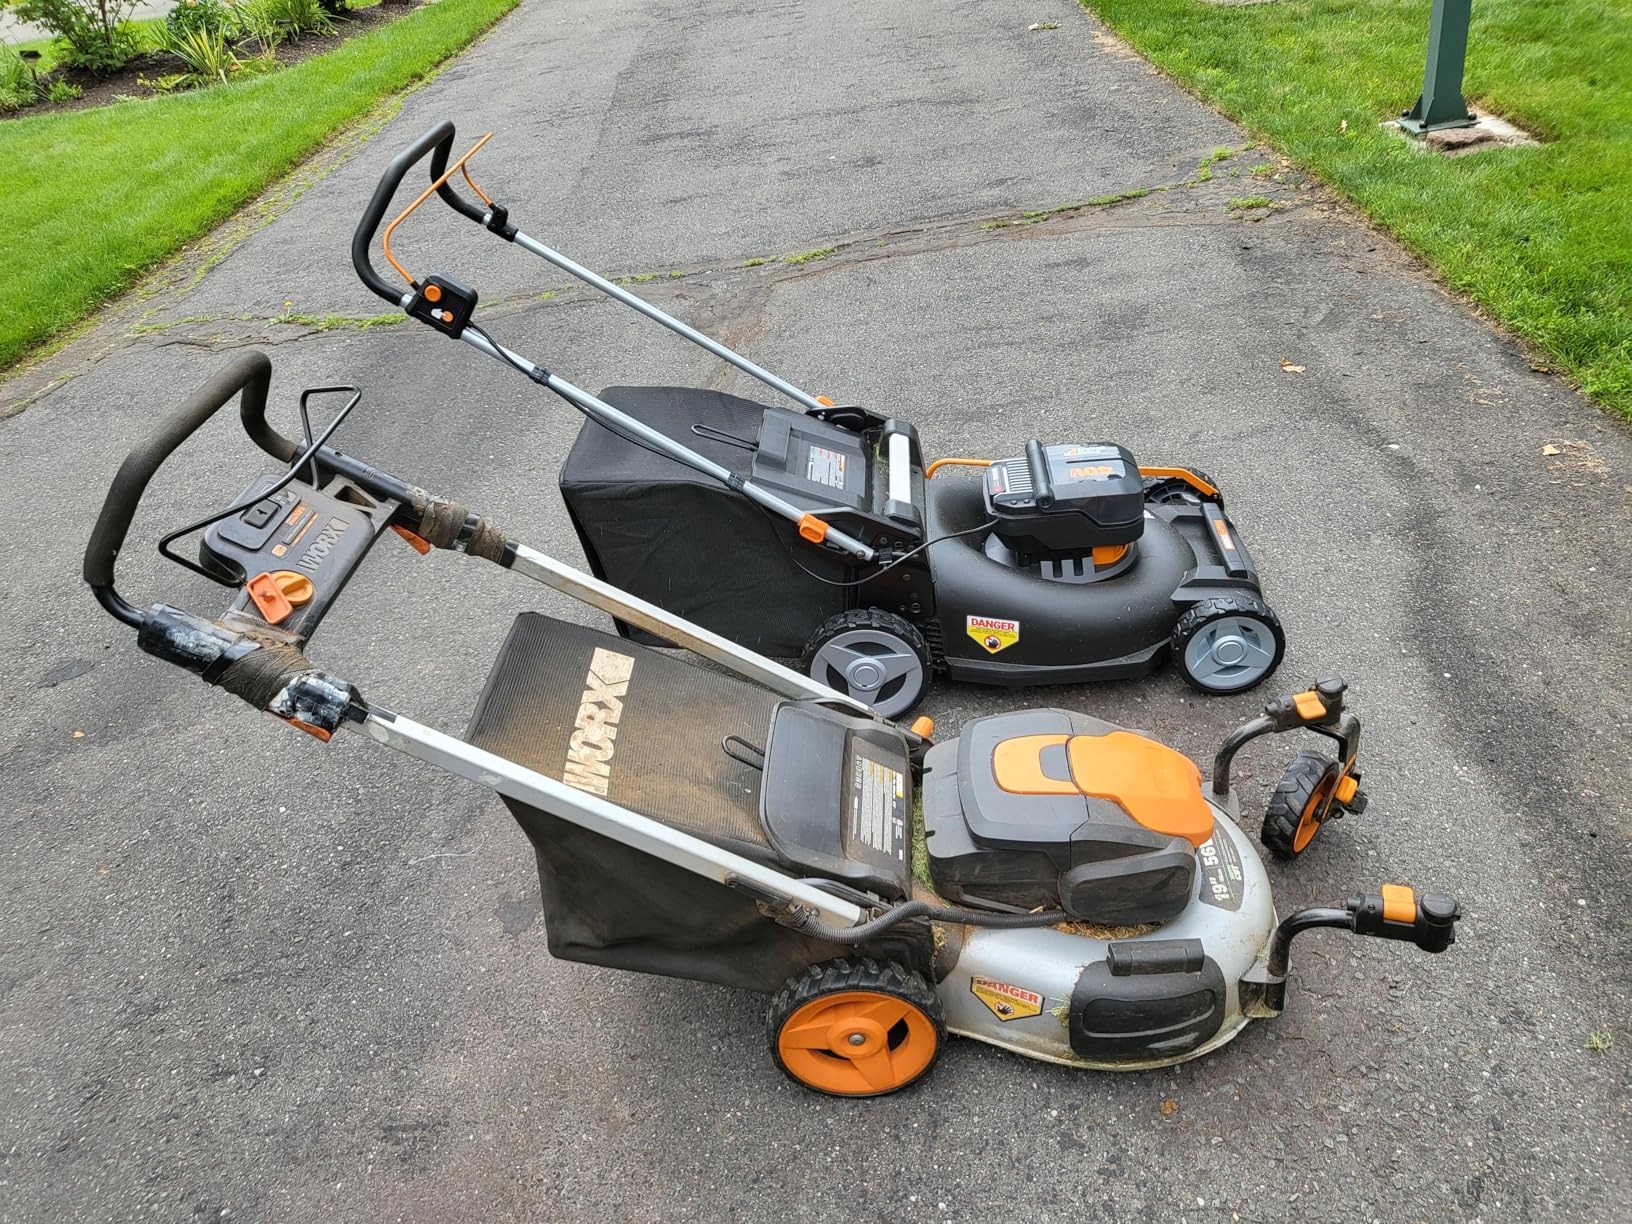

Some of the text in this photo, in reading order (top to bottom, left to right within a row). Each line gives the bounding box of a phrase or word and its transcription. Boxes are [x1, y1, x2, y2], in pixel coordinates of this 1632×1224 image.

[296, 520, 346, 573] WORX
[971, 617, 1015, 632] DANGER
[563, 659, 631, 796] WORX
[1209, 876, 1230, 901] 19"
[976, 979, 1039, 1004] DANGER
